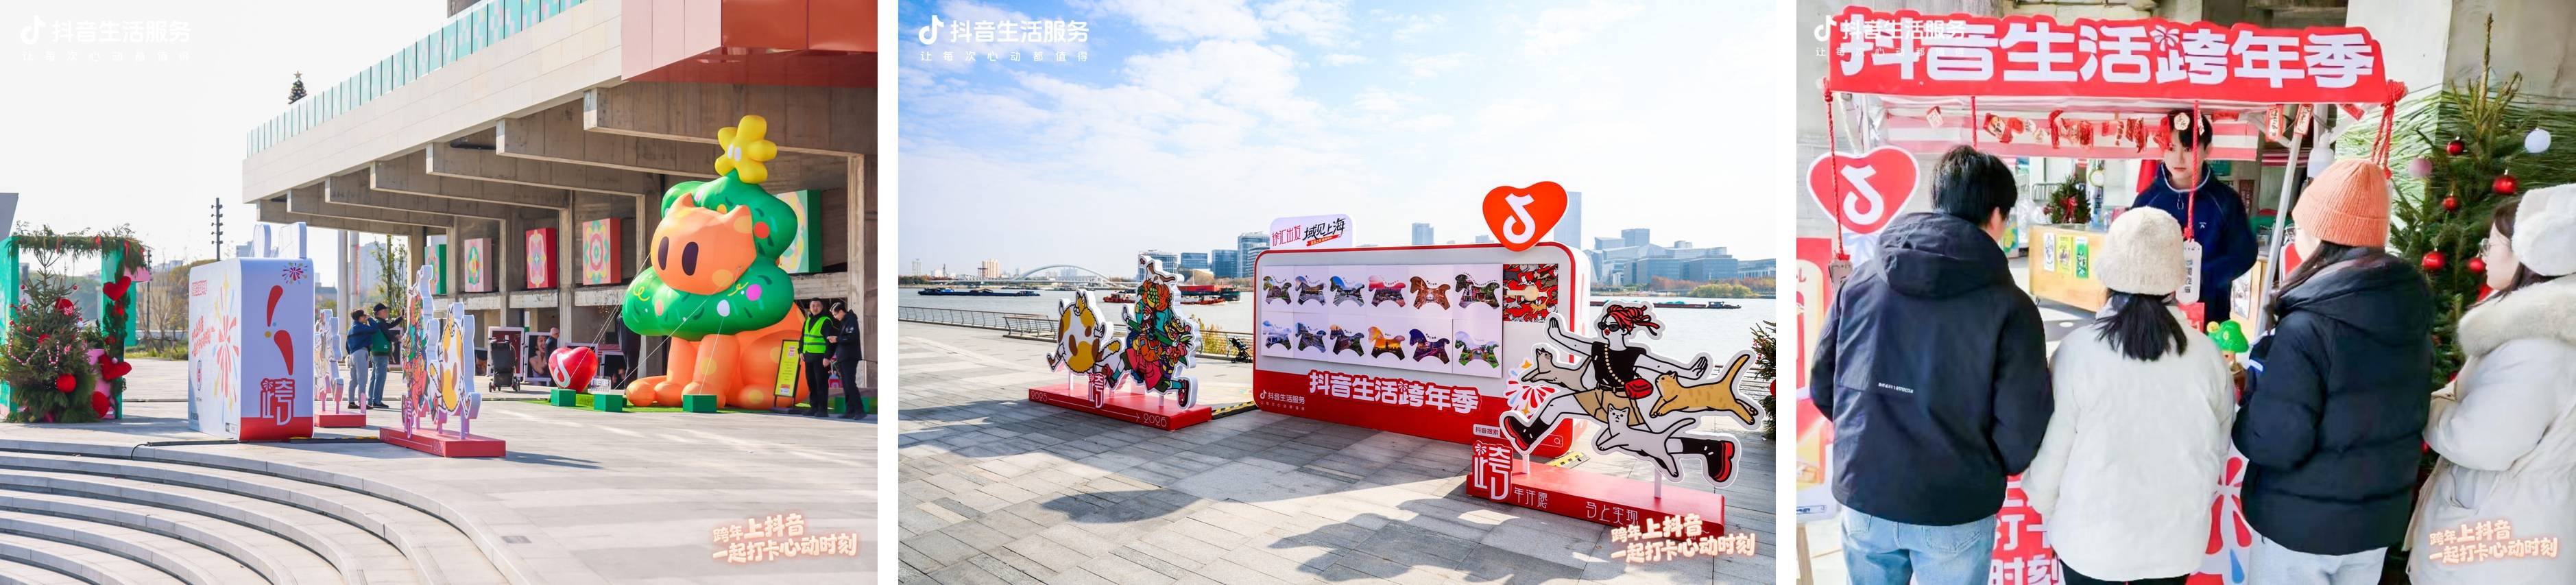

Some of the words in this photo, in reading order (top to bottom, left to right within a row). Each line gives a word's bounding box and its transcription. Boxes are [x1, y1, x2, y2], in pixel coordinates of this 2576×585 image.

[1840, 14, 2374, 88] 抖音生活跨年季
[1031, 390, 1048, 403] 2025
[1268, 391, 1305, 405] 抖音生活服务
[1309, 371, 1480, 414] 抖音生活跨年季
[1143, 412, 1167, 427] 2026
